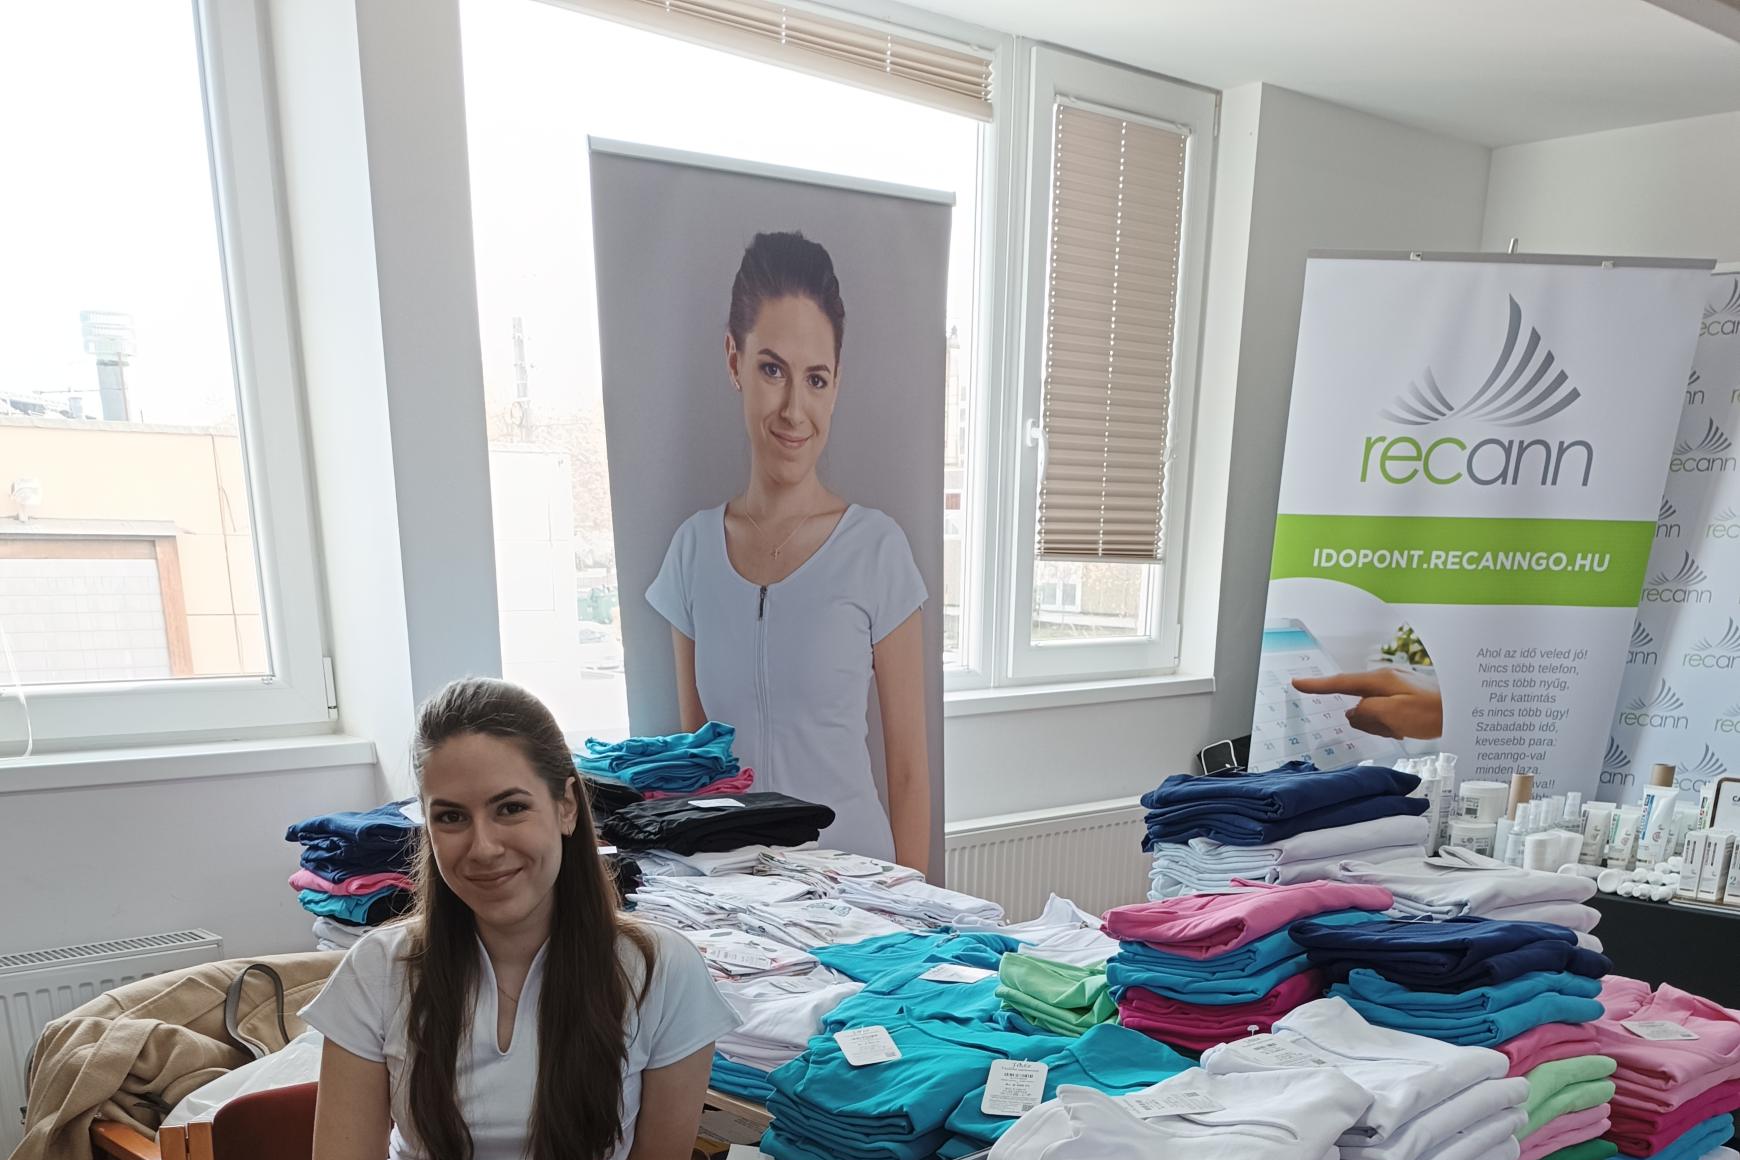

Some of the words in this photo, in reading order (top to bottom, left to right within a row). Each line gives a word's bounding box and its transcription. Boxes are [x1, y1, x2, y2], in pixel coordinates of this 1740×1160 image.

[1359, 435, 1594, 487] recann
[1669, 456, 1736, 473] ecann
[1313, 547, 1610, 573] IDOPONT.RECANNGO.HU
[1642, 588, 1712, 604] recann
[1476, 647, 1501, 659] Ahol
[1503, 649, 1517, 659] az
[1540, 648, 1572, 660] veled
[1478, 663, 1508, 674] Nincs
[1511, 662, 1535, 674] több
[1538, 662, 1580, 676] telefon,
[1481, 678, 1509, 688] nincs
[1512, 677, 1536, 689] több
[1489, 692, 1508, 703] Pár
[1510, 692, 1557, 704] kattintás
[1471, 706, 1484, 718] és
[1487, 707, 1515, 718] nincs
[1517, 707, 1542, 718] több
[1545, 707, 1570, 720] ügy!
[1475, 721, 1536, 732] Szabadabb
[1618, 711, 1689, 730] recann
[1475, 736, 1526, 747] kevesebb
[1477, 751, 1547, 763] recanngo-val
[1475, 764, 1513, 775] minden
